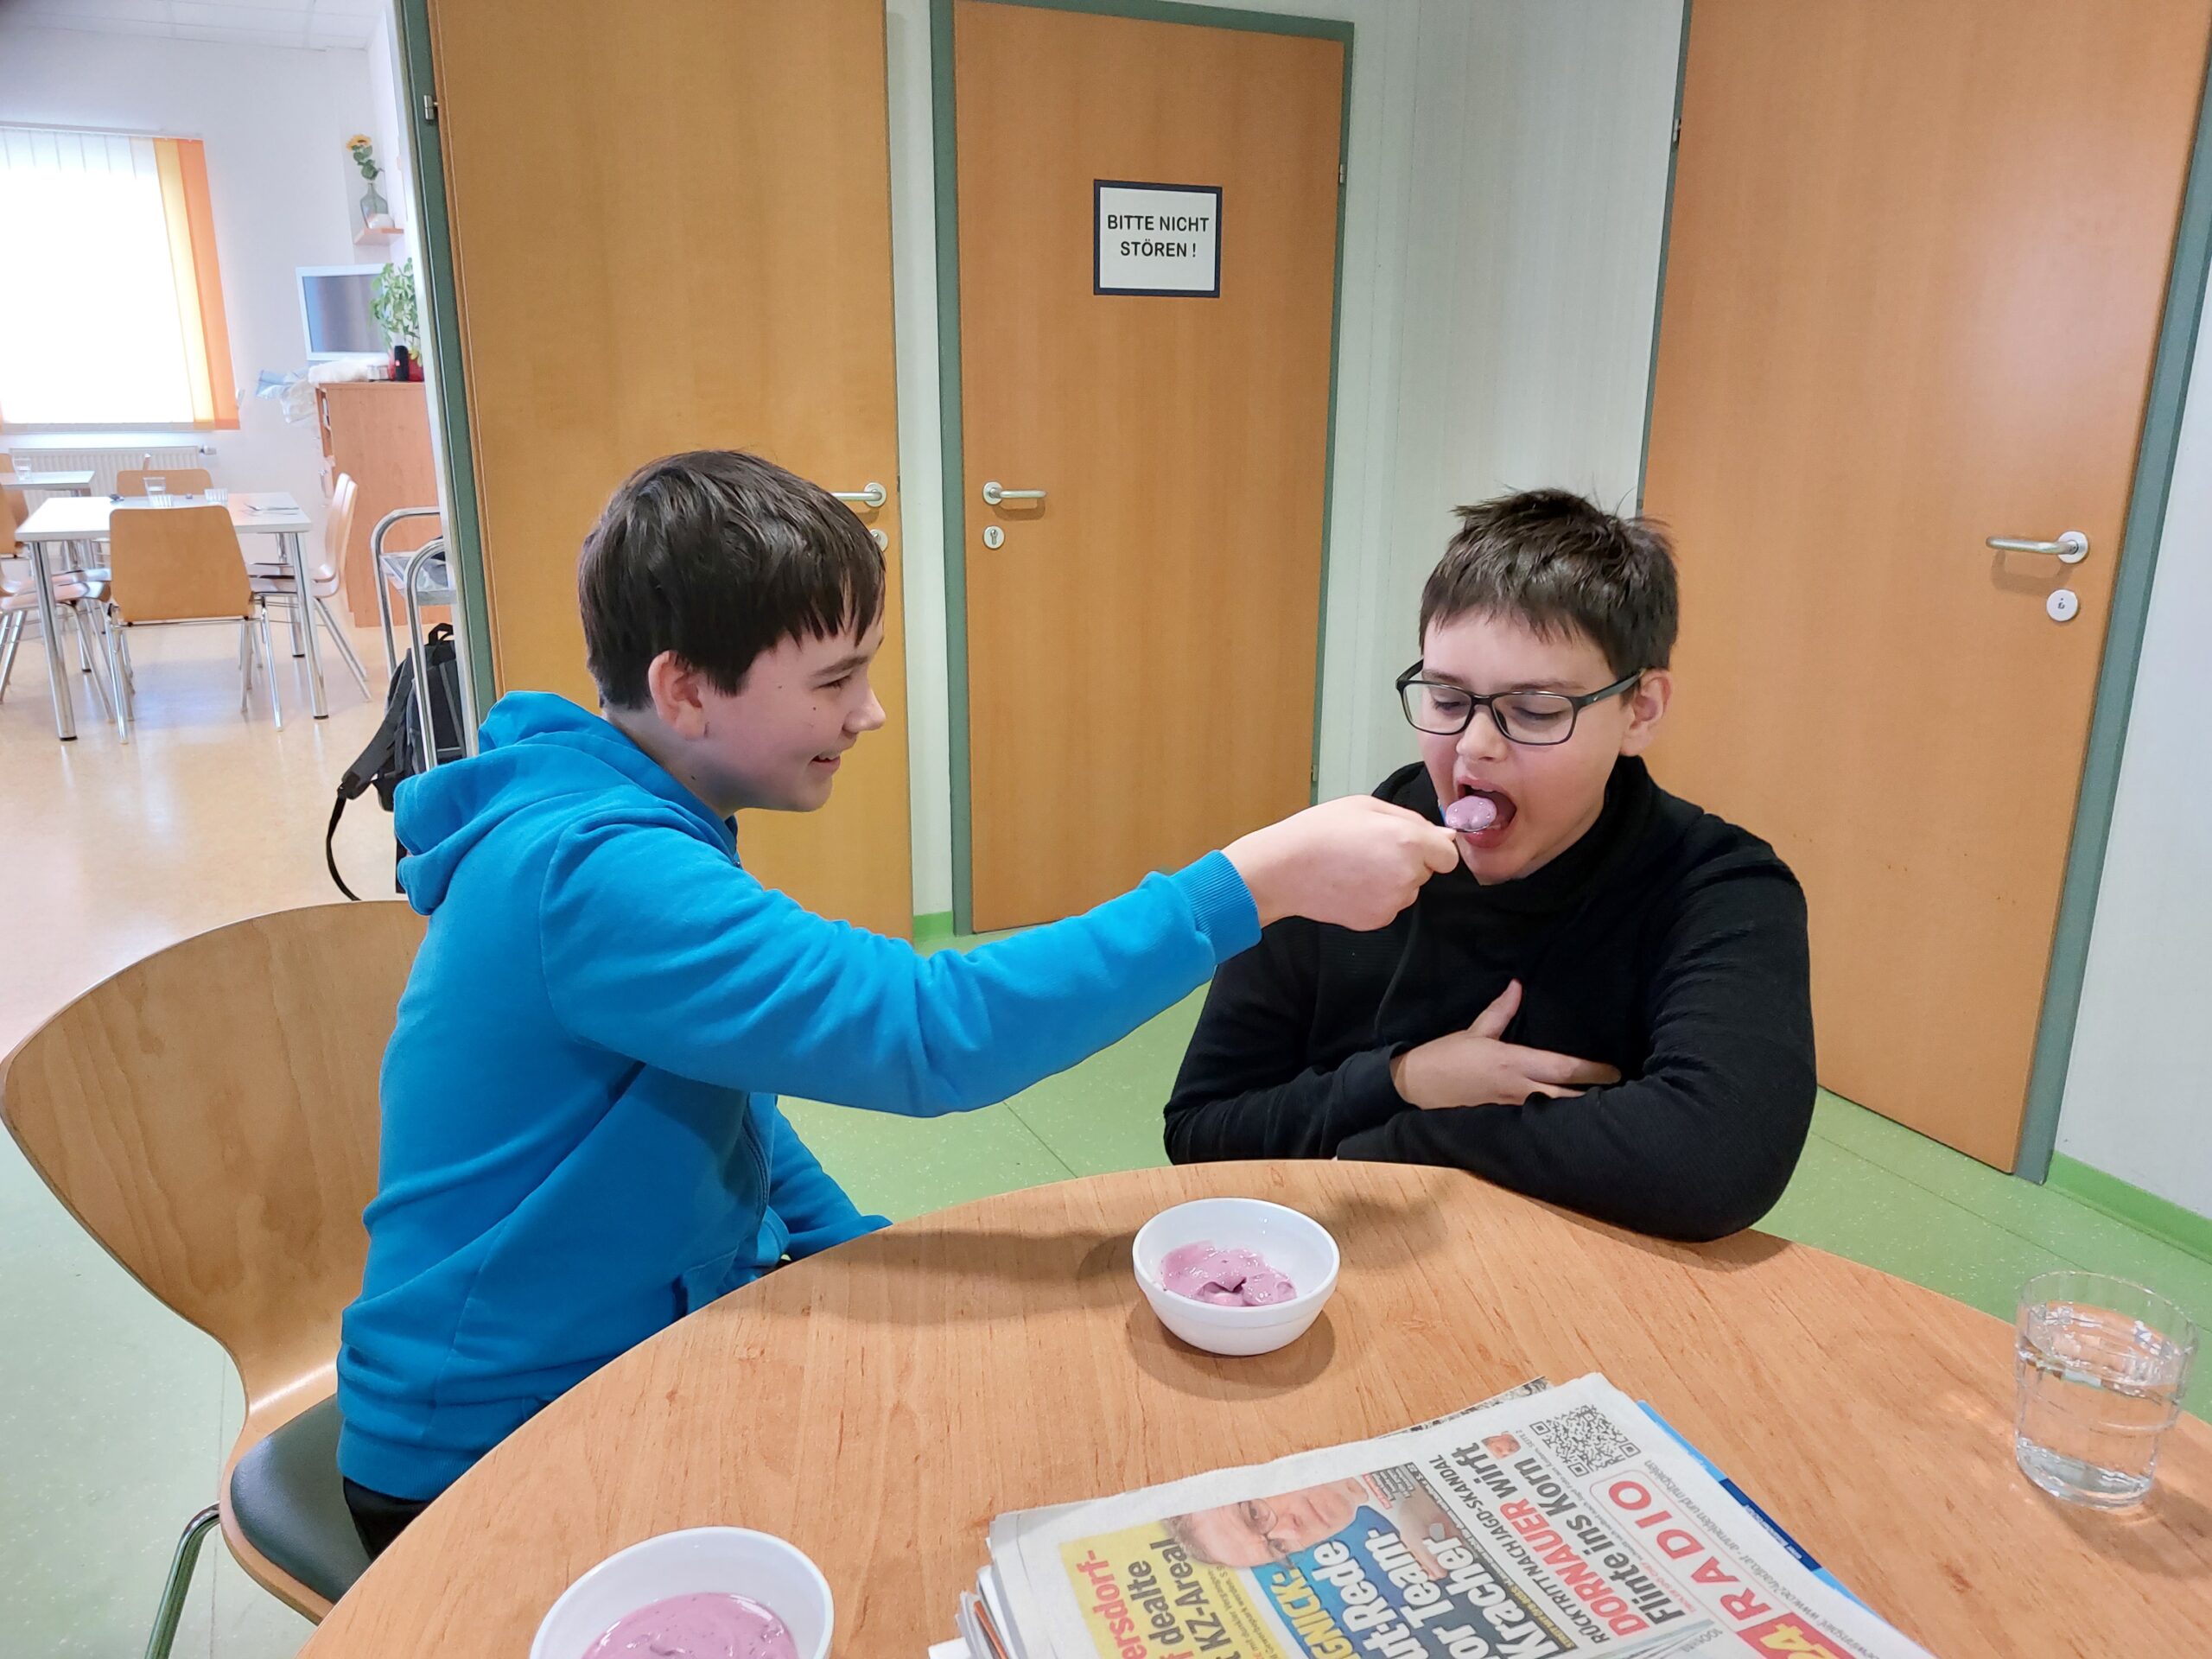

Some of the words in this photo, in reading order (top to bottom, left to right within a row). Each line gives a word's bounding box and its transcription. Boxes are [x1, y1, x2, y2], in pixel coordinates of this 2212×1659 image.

[1107, 214, 1154, 231] BITTE
[1160, 216, 1210, 232] NICHT
[1120, 238, 1187, 257] STÖREN
[1428, 1454, 1513, 1541] JAGD-SKANDAL
[1451, 1442, 1518, 1499] wirft
[1514, 1458, 1578, 1517] Korn
[1644, 1460, 1685, 1502] mitspielen
[1566, 1514, 1615, 1555] ins
[1681, 1497, 1700, 1517] und
[1697, 1511, 1739, 1551] anmelden
[1365, 1529, 1455, 1629] Team-
[1499, 1498, 1650, 1637] DORNAUER
[1502, 1540, 1543, 1577] NACH
[1608, 1480, 1771, 1621] RADIO
[1076, 1550, 1147, 1659] ersdorf-
[1127, 1560, 1185, 1645] dealte
[1149, 1538, 1232, 1652] KZ-Areal
[1270, 1568, 1362, 1659] GNICK:
[1422, 1537, 1560, 1659] Kracher
[1532, 1577, 1611, 1644] RÜCKTRITT
[1603, 1552, 1686, 1624] Flinte
[1431, 1624, 1502, 1659] or
